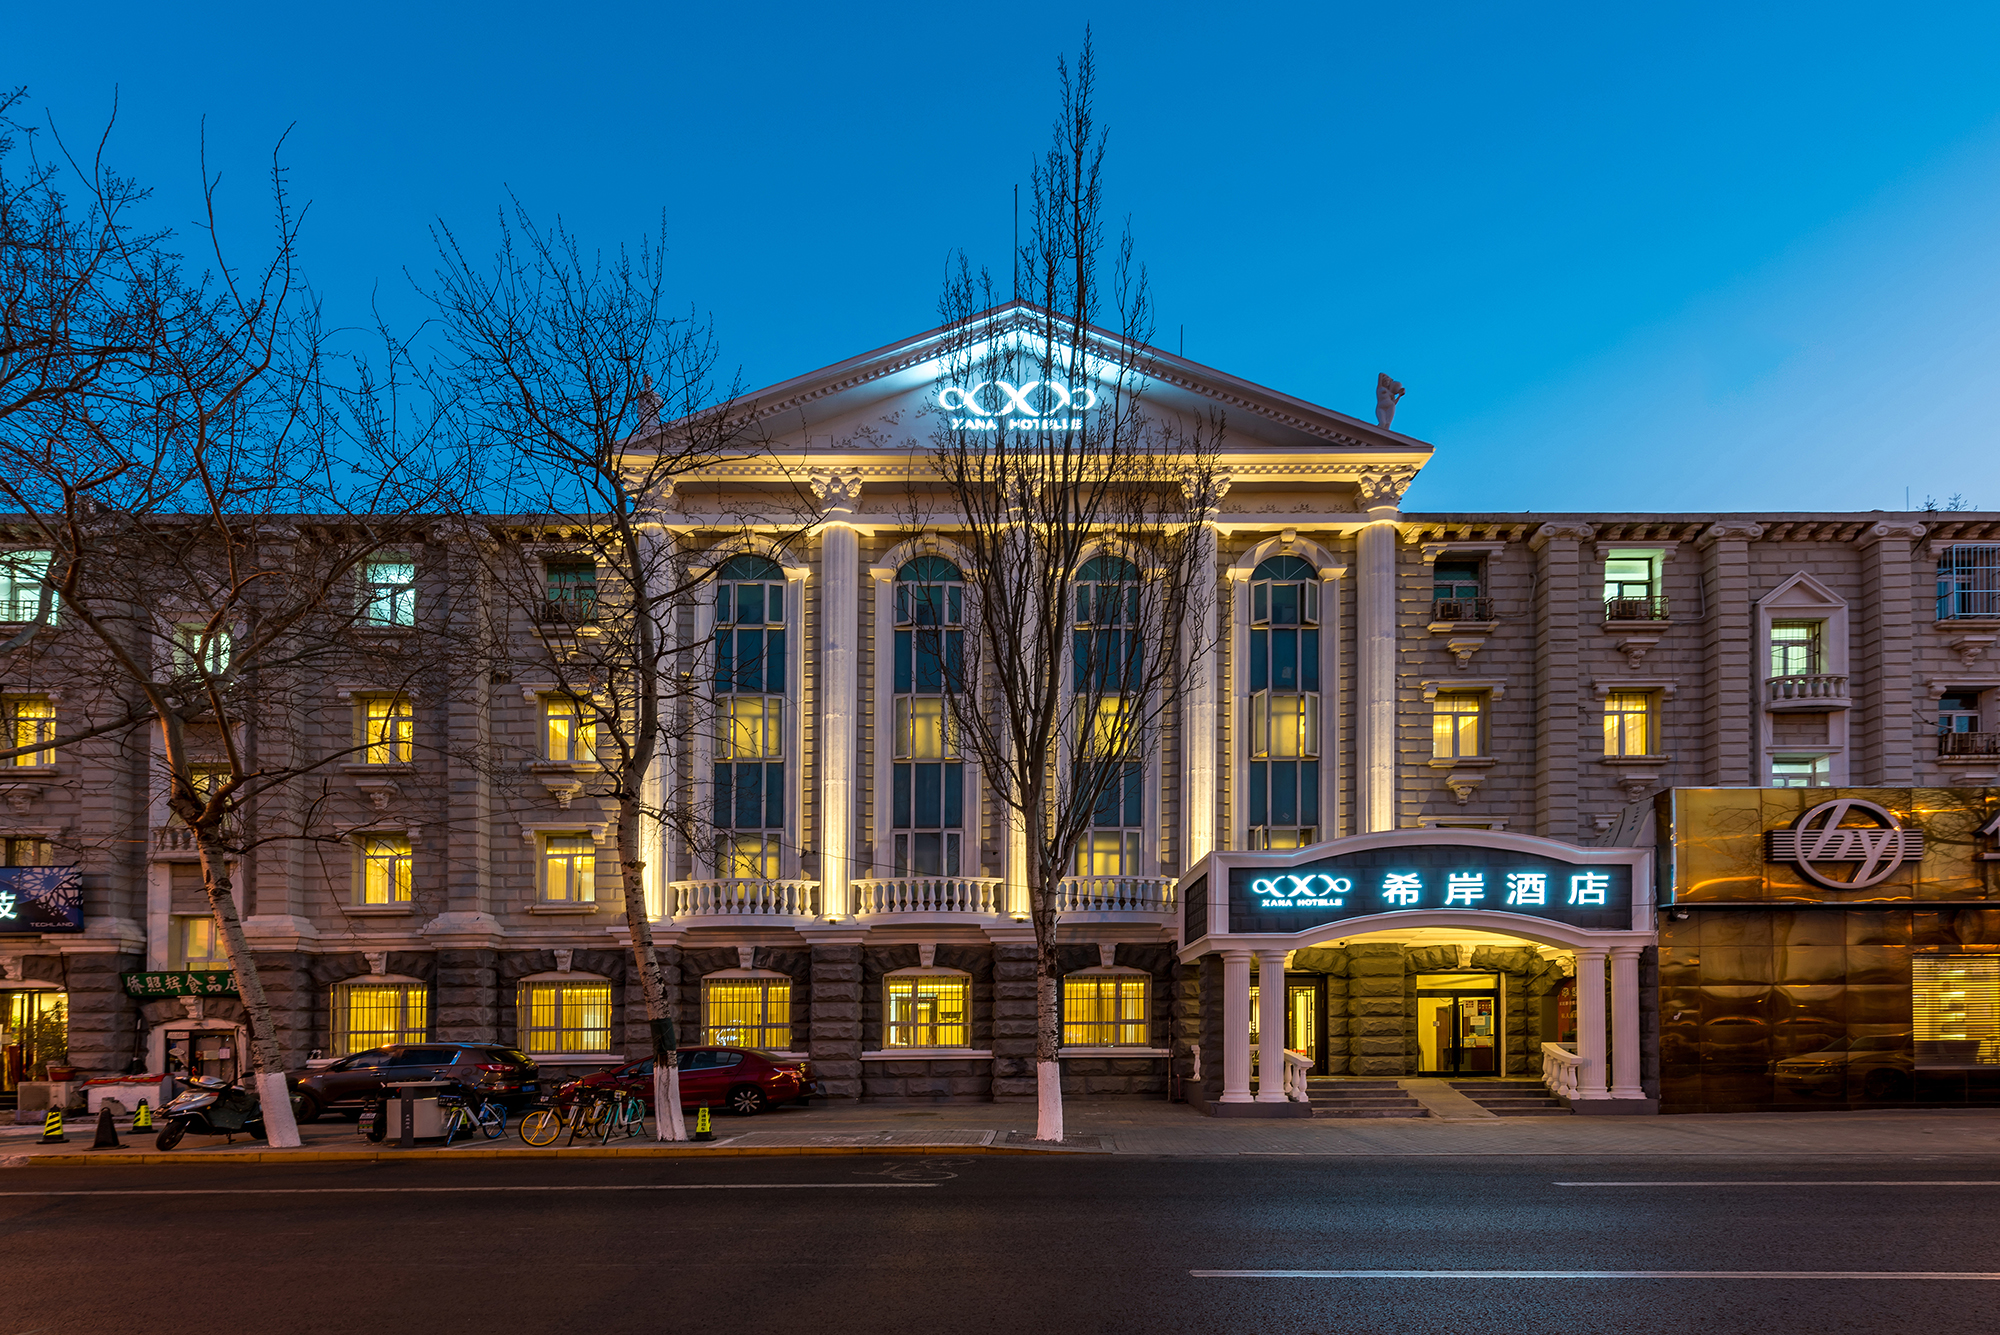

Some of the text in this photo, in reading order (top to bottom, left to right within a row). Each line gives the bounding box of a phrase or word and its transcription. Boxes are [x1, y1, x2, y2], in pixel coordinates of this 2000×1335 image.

[1382, 872, 1610, 905] 希岸酒店
[1262, 898, 1342, 907] XANA HOTELLE
